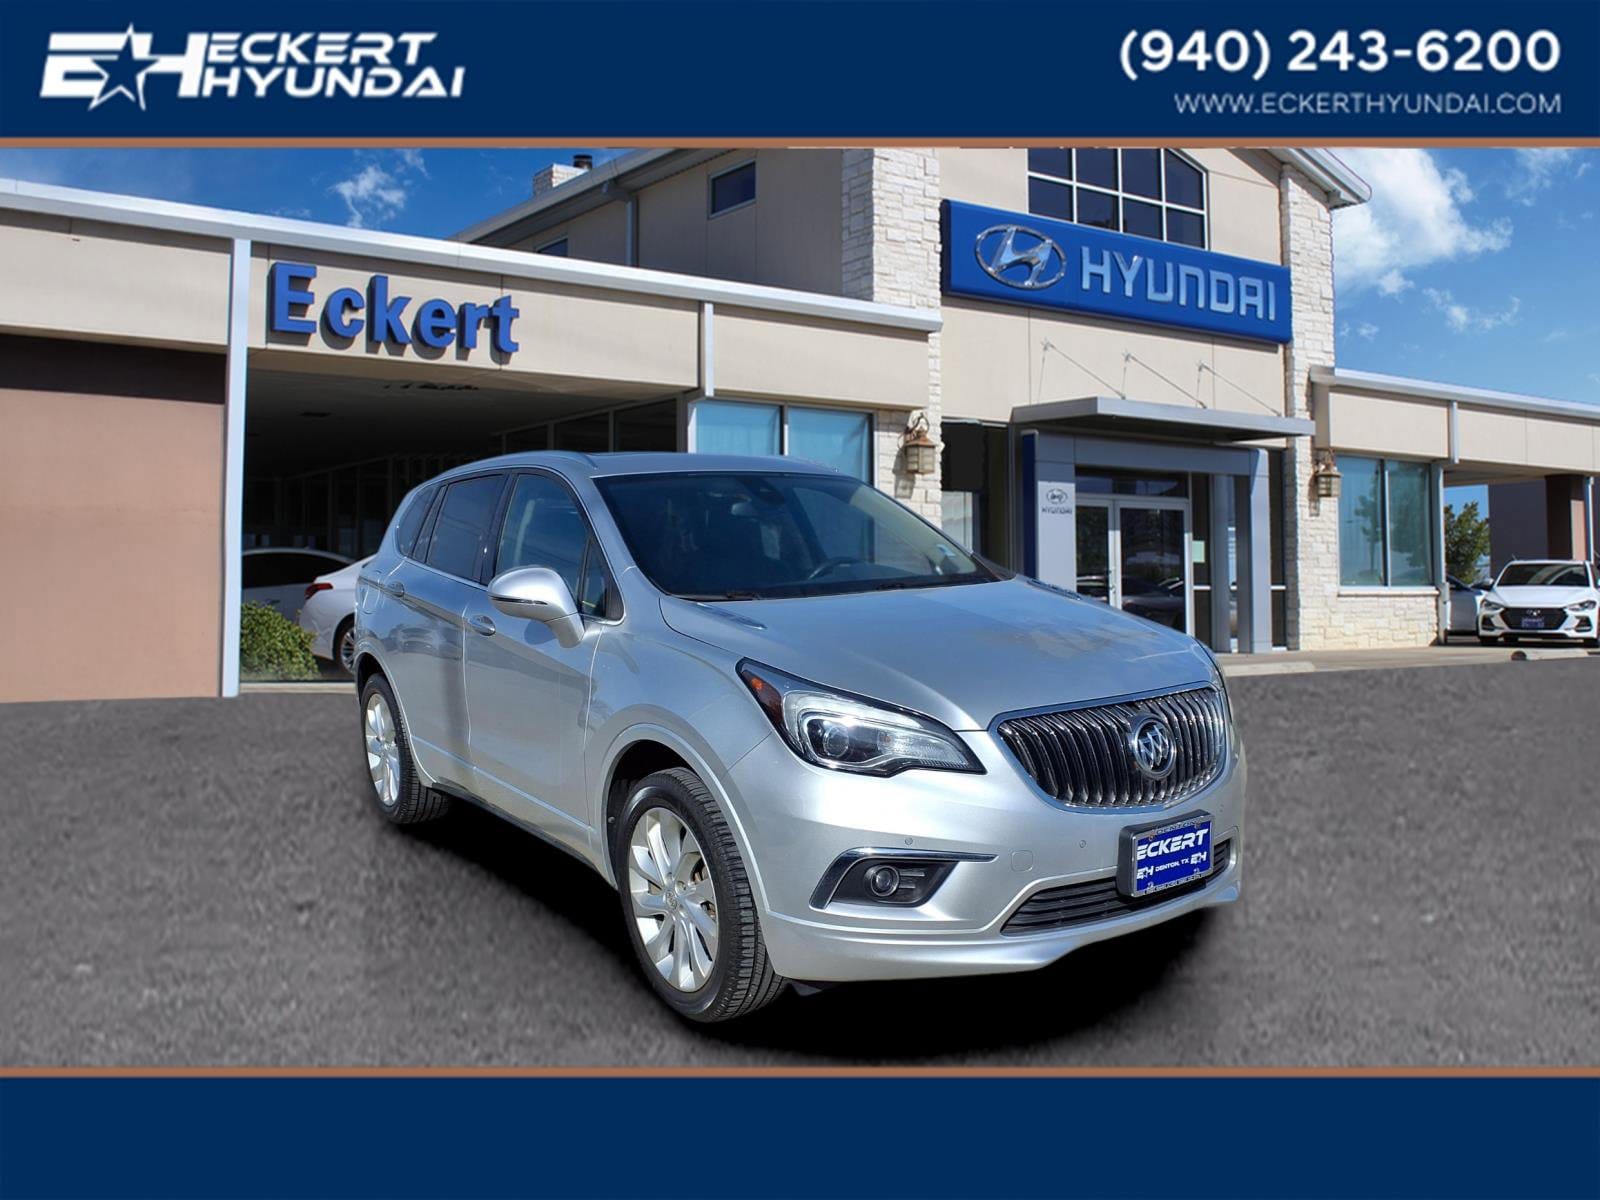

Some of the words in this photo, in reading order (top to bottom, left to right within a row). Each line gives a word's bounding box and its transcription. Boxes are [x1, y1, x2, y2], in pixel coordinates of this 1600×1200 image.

[267, 262, 520, 353] Eckert
[1081, 246, 1276, 321] HYUNDAI
[1042, 506, 1073, 515] HYUNDAI
[1136, 828, 1209, 861] ECKERT
